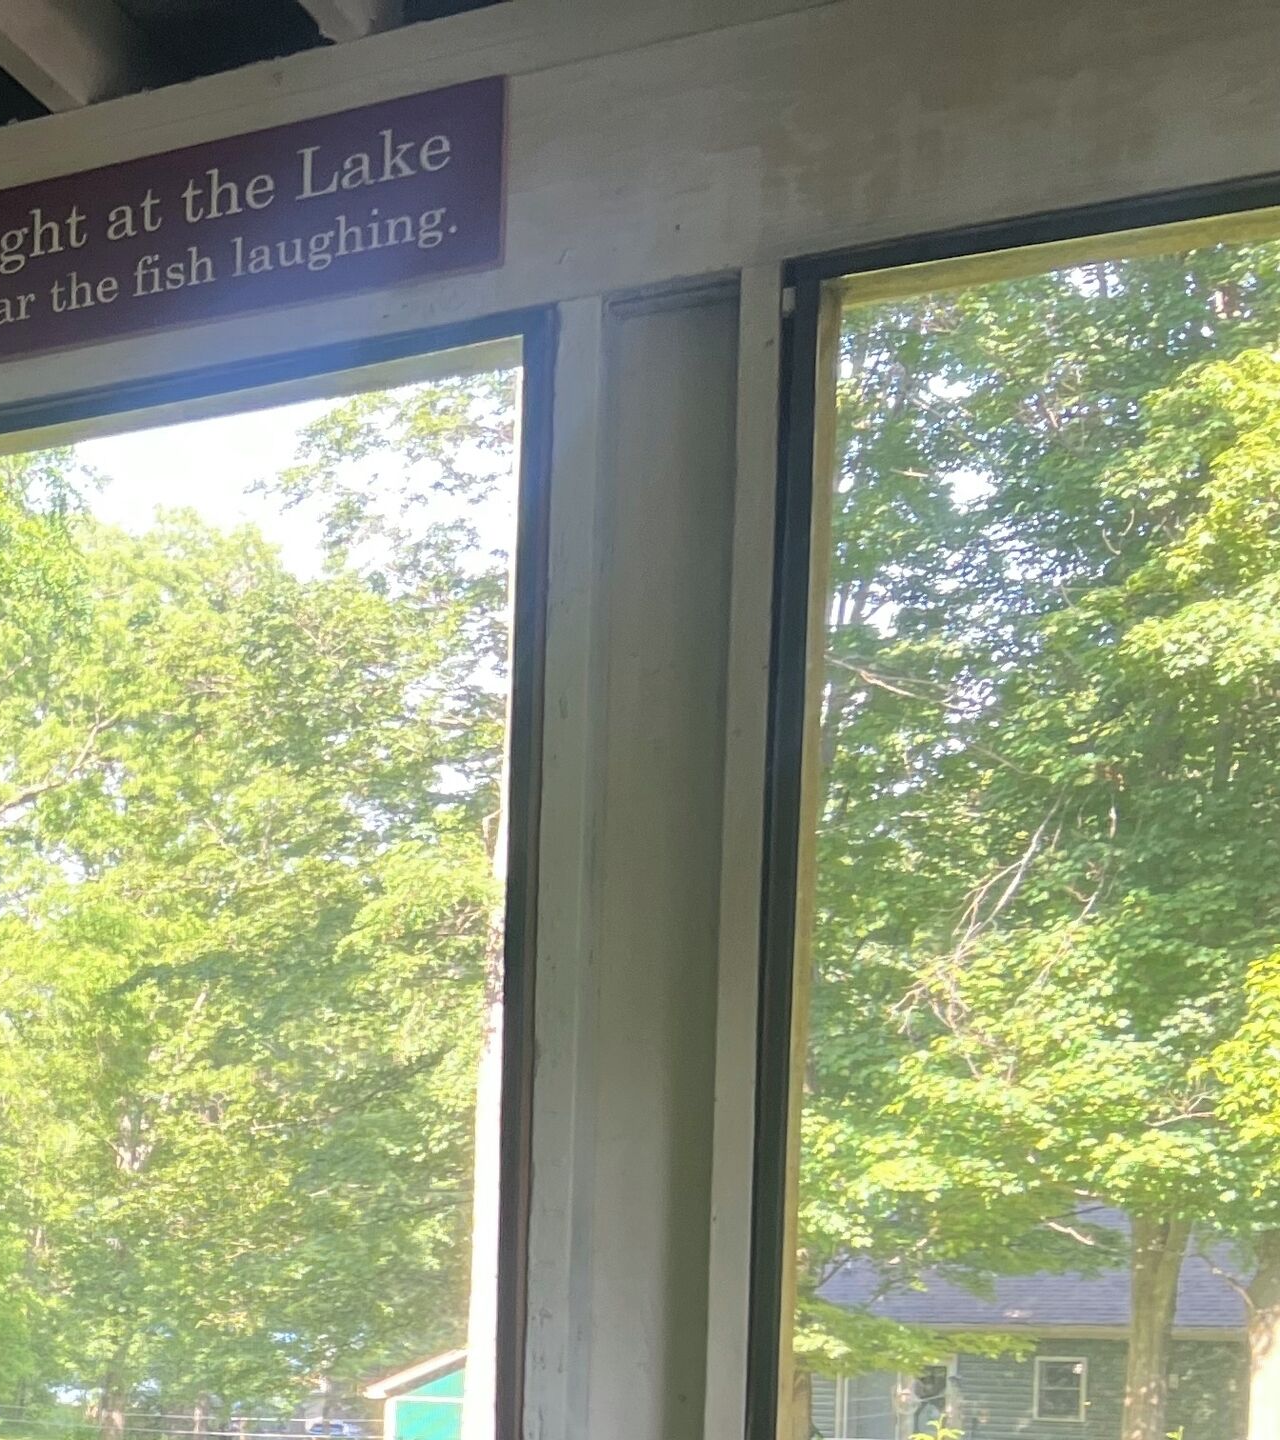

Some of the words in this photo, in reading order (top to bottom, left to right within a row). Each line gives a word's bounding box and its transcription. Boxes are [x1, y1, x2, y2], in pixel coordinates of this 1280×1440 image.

[107, 188, 162, 241] at
[182, 168, 276, 224] the
[295, 129, 452, 202] Lake
[50, 271, 119, 313] the
[132, 247, 216, 298] fish
[231, 206, 458, 278] laughing.
